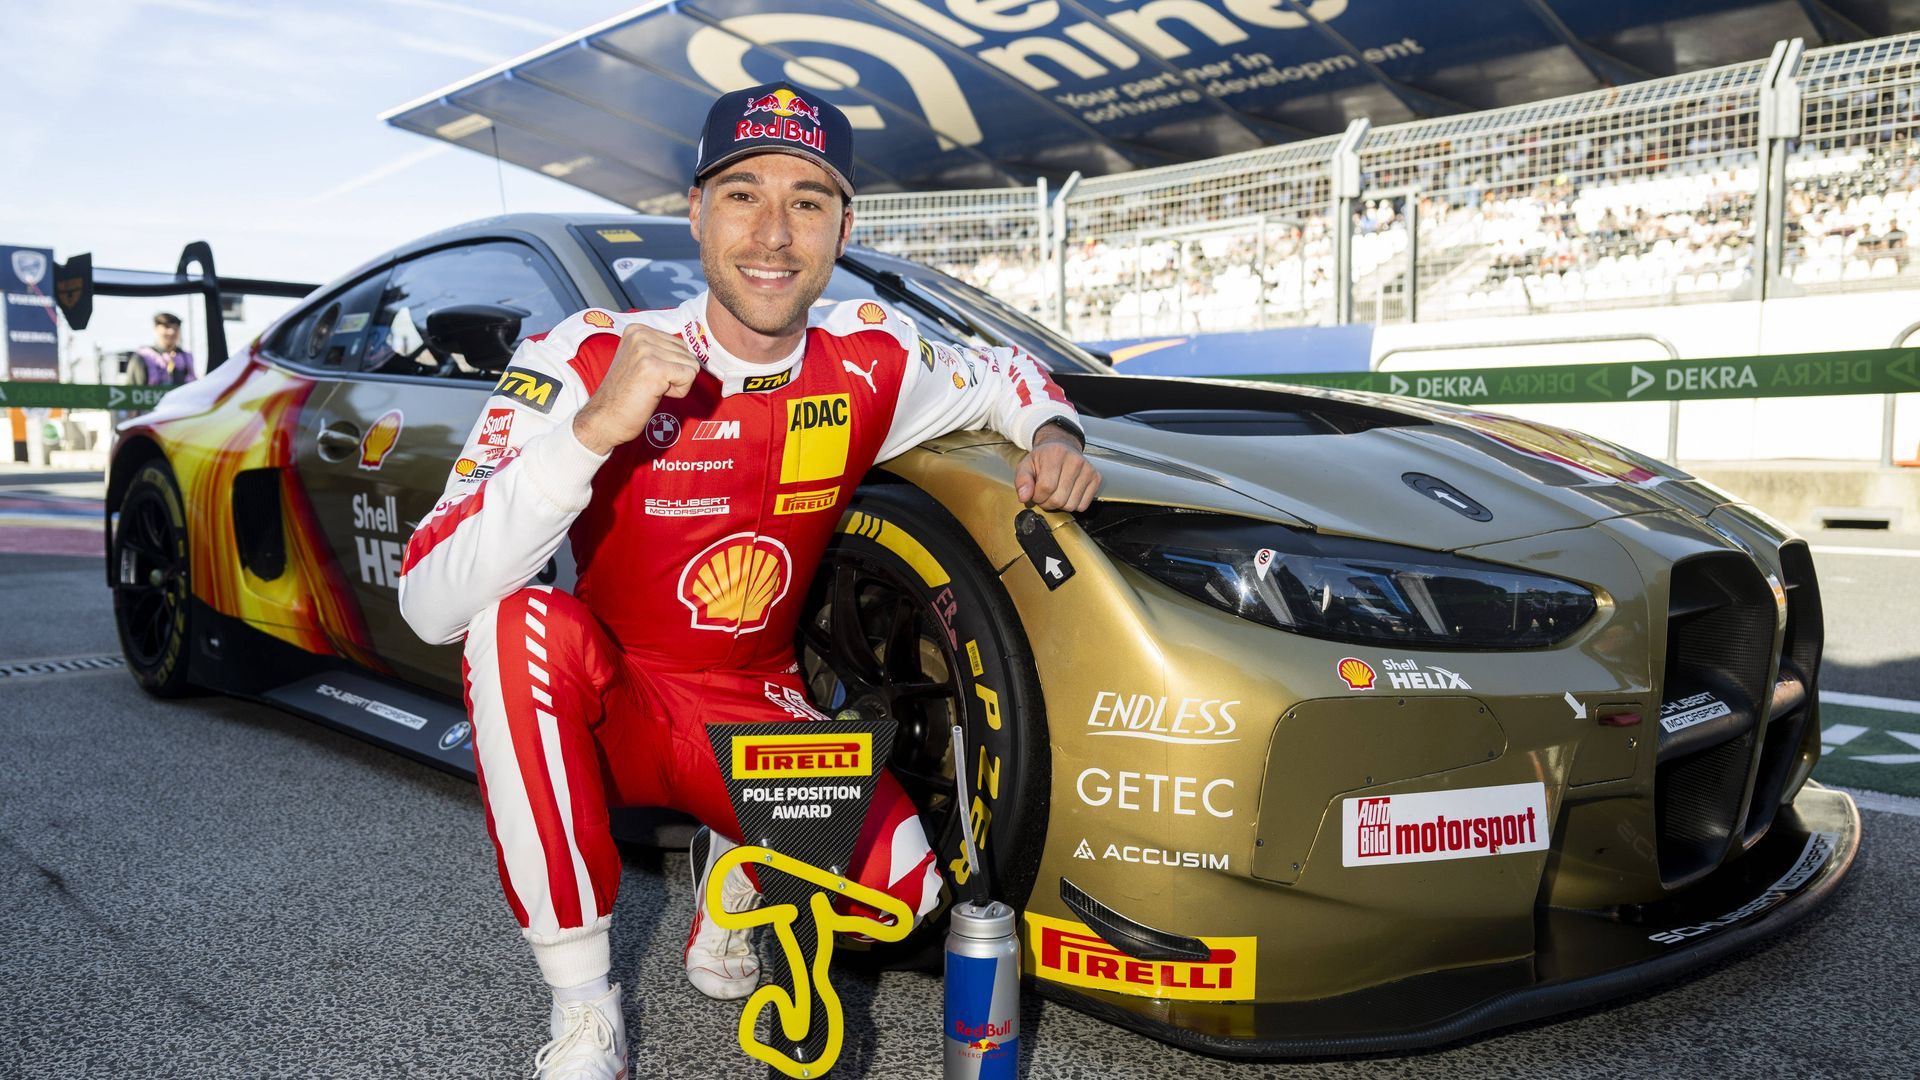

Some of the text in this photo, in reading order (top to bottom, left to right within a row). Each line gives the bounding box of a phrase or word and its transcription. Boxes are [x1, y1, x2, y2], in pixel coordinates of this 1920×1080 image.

[1056, 84, 1119, 110] Your
[1233, 50, 1274, 71] in
[1083, 88, 1201, 124] software
[735, 116, 827, 154] Red Bull
[684, 320, 710, 366] Red Bull
[747, 371, 790, 391] DTM
[1416, 374, 1489, 400] DEKRA
[1666, 364, 1758, 391] DEKRA
[132, 389, 168, 405] DEK
[483, 413, 513, 434] Sport
[790, 397, 848, 432] ADAC
[488, 433, 507, 445] Bild
[652, 458, 734, 472] Motorsport
[352, 493, 398, 533] Shell
[645, 496, 730, 507] SCHUBERT
[649, 506, 727, 516] MOTORSPORT
[782, 490, 836, 512] PIRELLI
[1384, 658, 1418, 671] Shell
[1389, 666, 1473, 690] HELIX
[1088, 691, 1241, 735] ENDLESS
[1660, 691, 1717, 720] CHUBERT
[1665, 703, 1727, 730] MOTORSPORT
[745, 743, 861, 771] PIRELLI
[743, 786, 861, 802] POLE POSITION
[1076, 768, 1235, 818] GETEC
[771, 804, 832, 819] AWARD
[948, 745, 1001, 885] ZER
[1358, 799, 1391, 827] Auto
[1359, 825, 1390, 857] Bild
[1395, 806, 1537, 855] motorsport
[1103, 844, 1229, 871] ACCUSIM
[1041, 927, 1237, 989] PIRELLI
[955, 1020, 1012, 1038] Red Bull
